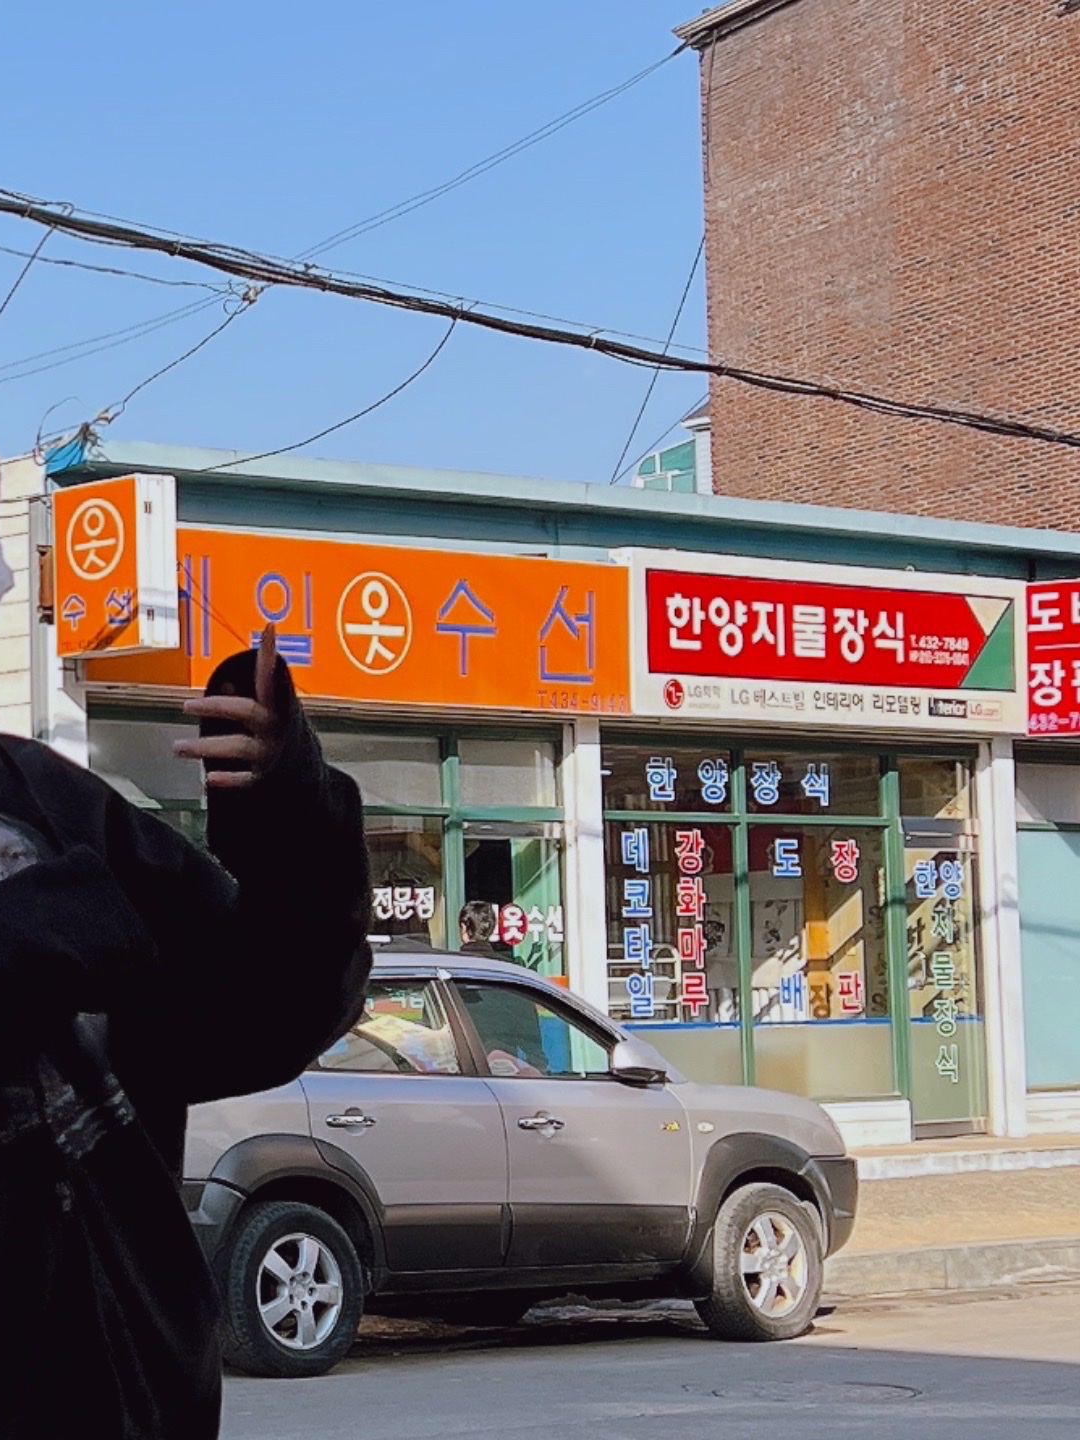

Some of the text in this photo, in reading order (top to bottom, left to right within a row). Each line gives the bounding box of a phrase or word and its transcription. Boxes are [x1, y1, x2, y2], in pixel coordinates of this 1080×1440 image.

[62, 587, 133, 631] 수선
[666, 593, 905, 663] 한양지물장식
[1028, 592, 1080, 632] 도
[731, 688, 750, 705] LG
[814, 690, 864, 713] 인테리어
[1029, 711, 1080, 731] 432-7
[913, 860, 963, 899] 한양
[372, 886, 435, 920] 전문점
